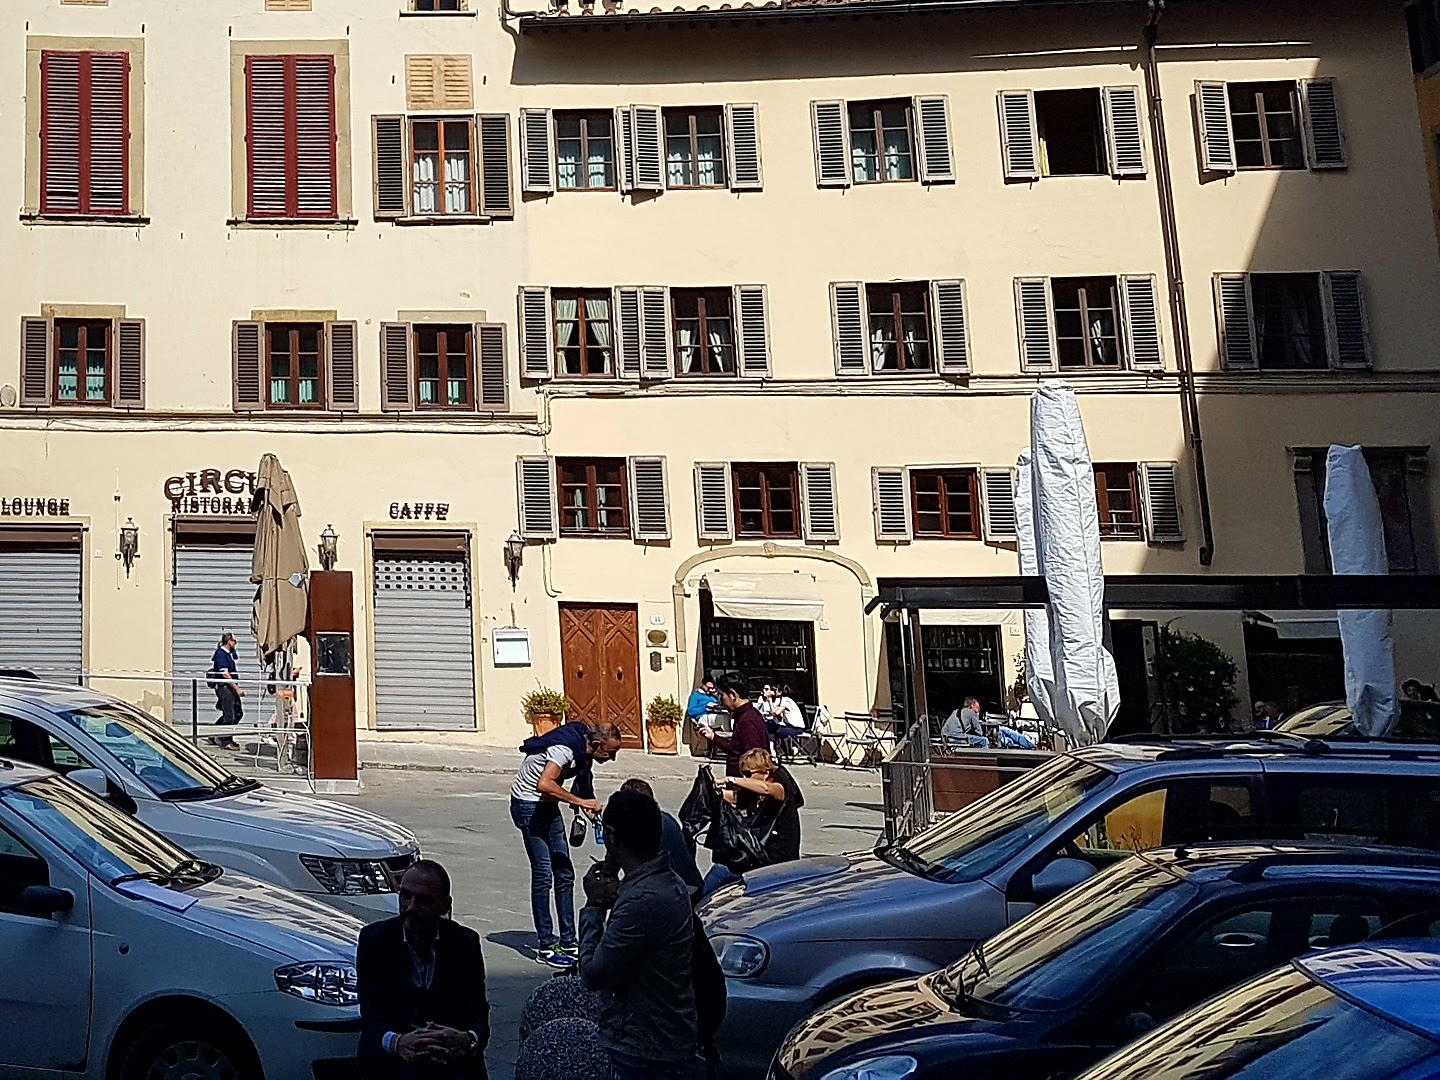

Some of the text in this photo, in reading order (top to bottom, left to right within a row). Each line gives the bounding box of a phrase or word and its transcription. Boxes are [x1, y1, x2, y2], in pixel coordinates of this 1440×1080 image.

[164, 469, 257, 501] CIRCU
[1, 497, 70, 516] LOUNGE
[171, 497, 253, 514] RISTORA
